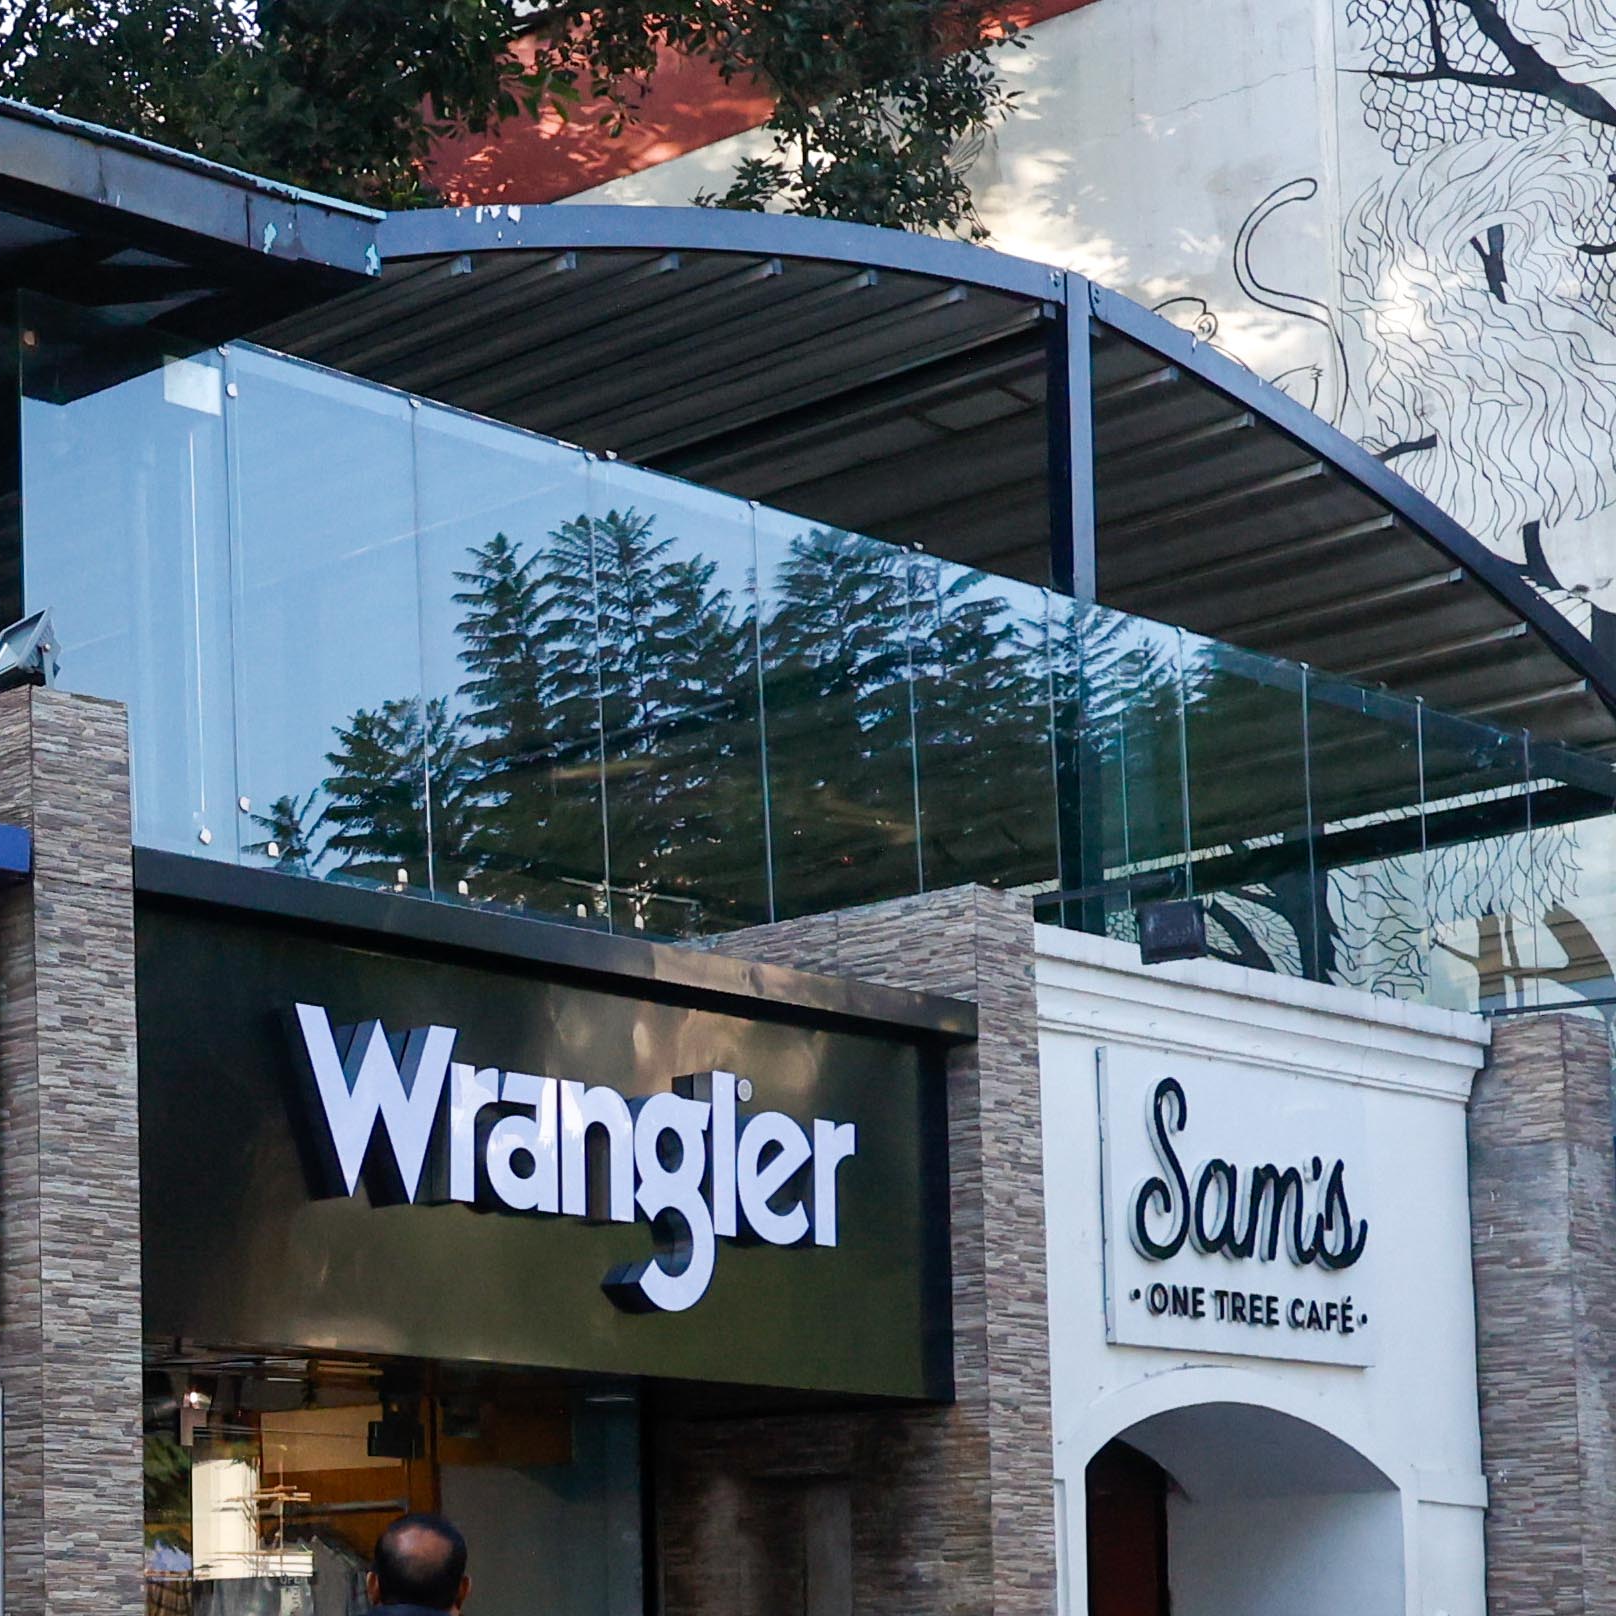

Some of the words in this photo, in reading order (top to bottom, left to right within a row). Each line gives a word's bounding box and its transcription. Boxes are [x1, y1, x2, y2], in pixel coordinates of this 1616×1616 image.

[295, 1002, 855, 1312] Wrangler
[1129, 1077, 1368, 1270] Sam's
[1148, 1282, 1205, 1318] ONE
[1212, 1288, 1279, 1326] TREE
[1289, 1295, 1354, 1333] CAFÉ
